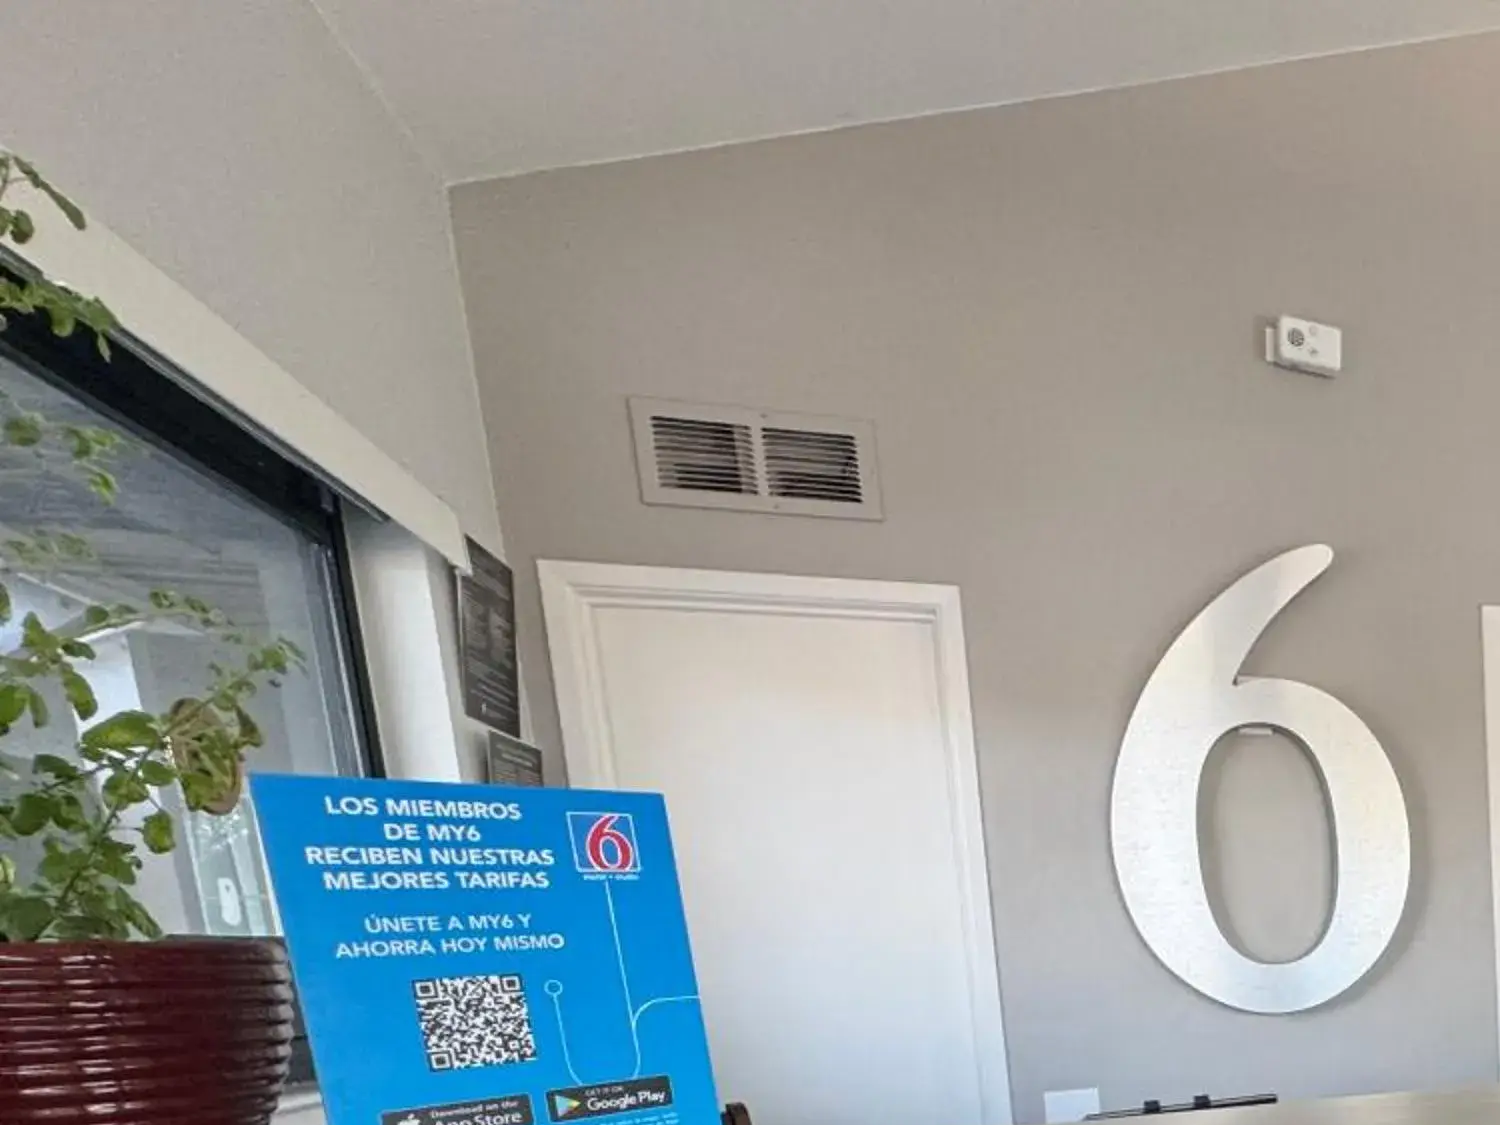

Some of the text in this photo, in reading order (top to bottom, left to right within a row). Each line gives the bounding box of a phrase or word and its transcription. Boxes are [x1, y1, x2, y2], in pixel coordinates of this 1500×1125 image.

[1110, 543, 1411, 1014] 6
[325, 796, 522, 820] LOS MIEMBROS
[383, 823, 481, 842] DE MY6
[586, 812, 634, 873] 6
[304, 846, 555, 866] RECIBEN NUESTRAS
[323, 871, 550, 890] MEJORES TARIFAS
[364, 912, 532, 934] ÚNETE A MY6 Y
[335, 933, 565, 959] AHORRA HOY MISMO
[586, 1090, 666, 1111] Google Play
